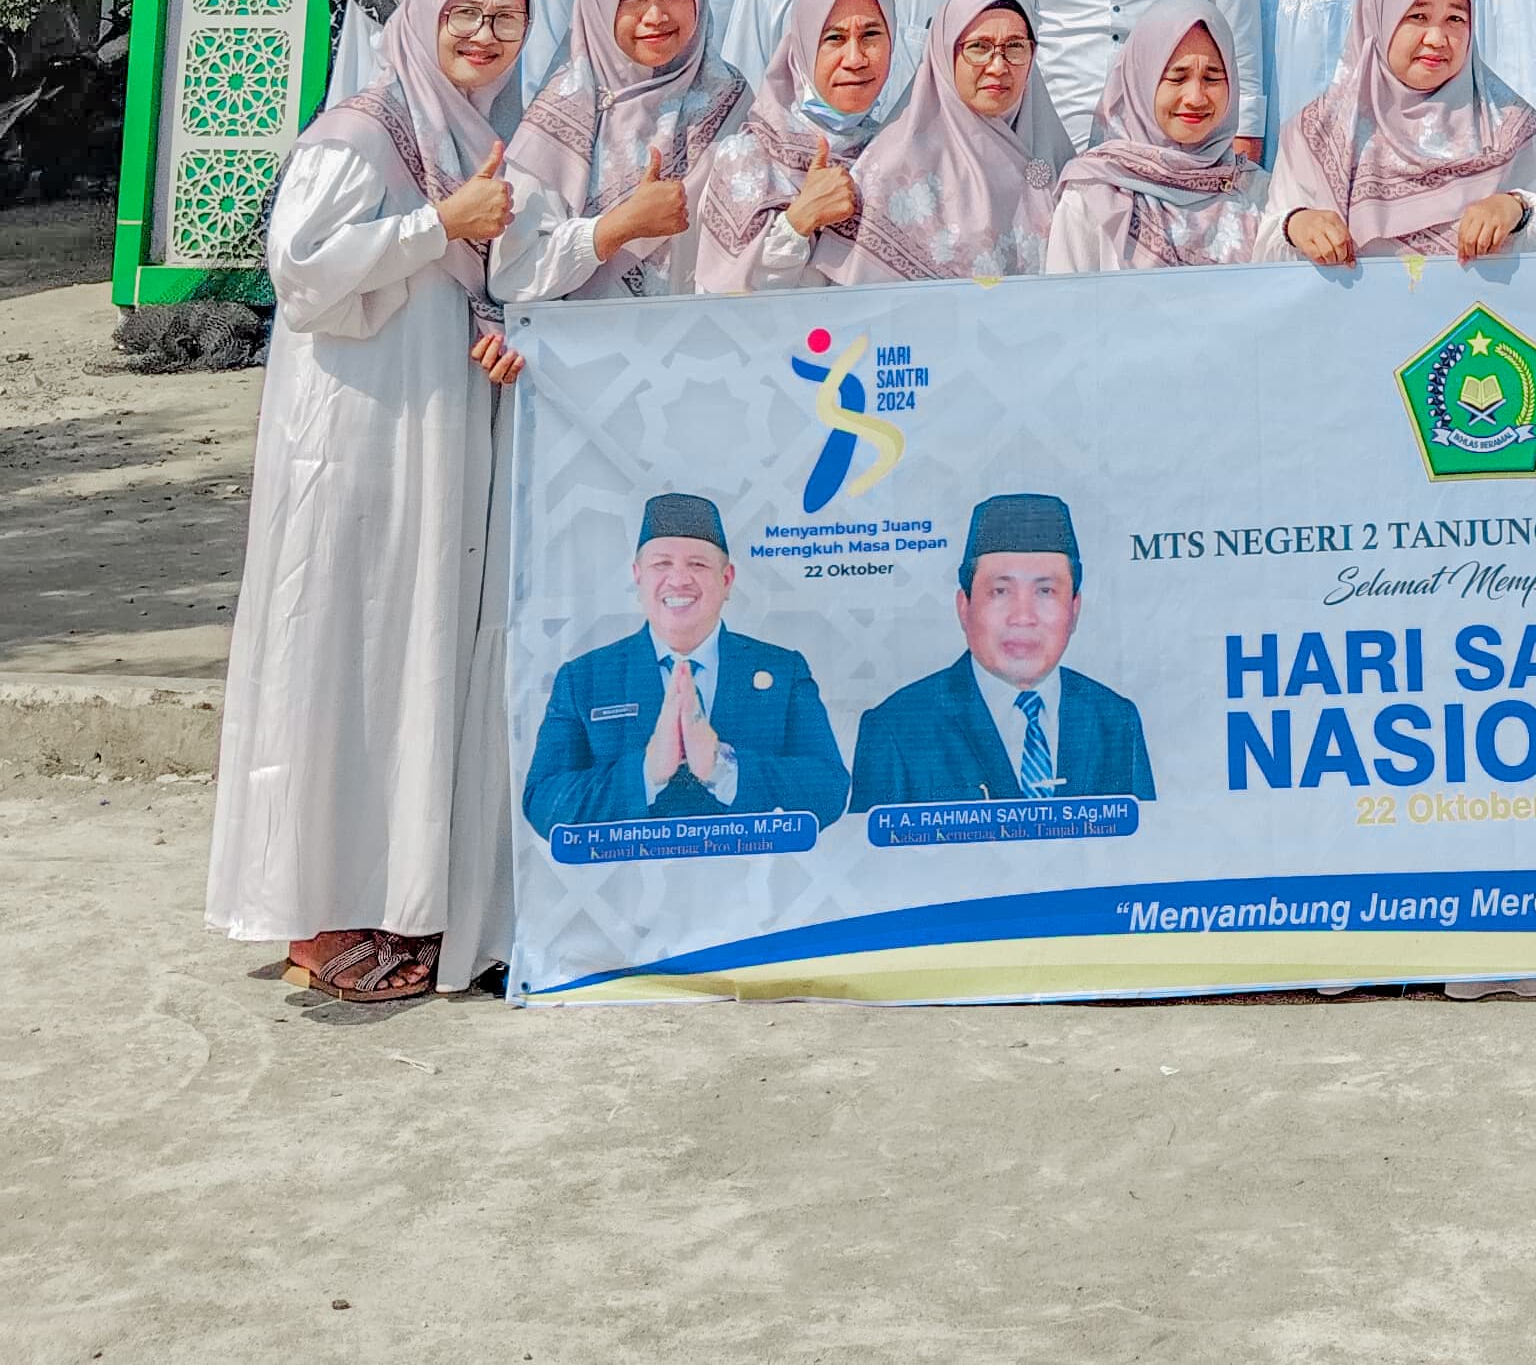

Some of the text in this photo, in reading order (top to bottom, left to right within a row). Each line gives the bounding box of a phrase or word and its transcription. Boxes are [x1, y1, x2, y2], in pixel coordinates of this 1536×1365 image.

[877, 346, 911, 366] HARI
[876, 367, 929, 389] SANTRI
[877, 390, 916, 412] 2024
[765, 519, 933, 540] Menyambung Juang
[750, 537, 948, 558] Merengkuh Masa Depan
[1130, 533, 1206, 561] MTS
[1214, 523, 1353, 557] NEGERI
[1362, 522, 1379, 551] 2
[804, 562, 894, 578] 22 Oktober
[1323, 565, 1452, 606] Selamat
[1225, 628, 1424, 699] HARI
[879, 814, 894, 828] H.
[900, 812, 915, 827] A.
[921, 809, 992, 826] RAHMAN
[996, 806, 1057, 823] SAYUTI,
[1356, 796, 1397, 825] 22
[562, 830, 582, 845] Dr.
[587, 829, 604, 842] H.
[609, 825, 671, 841] Mahbub
[1359, 890, 1459, 927] Juang
